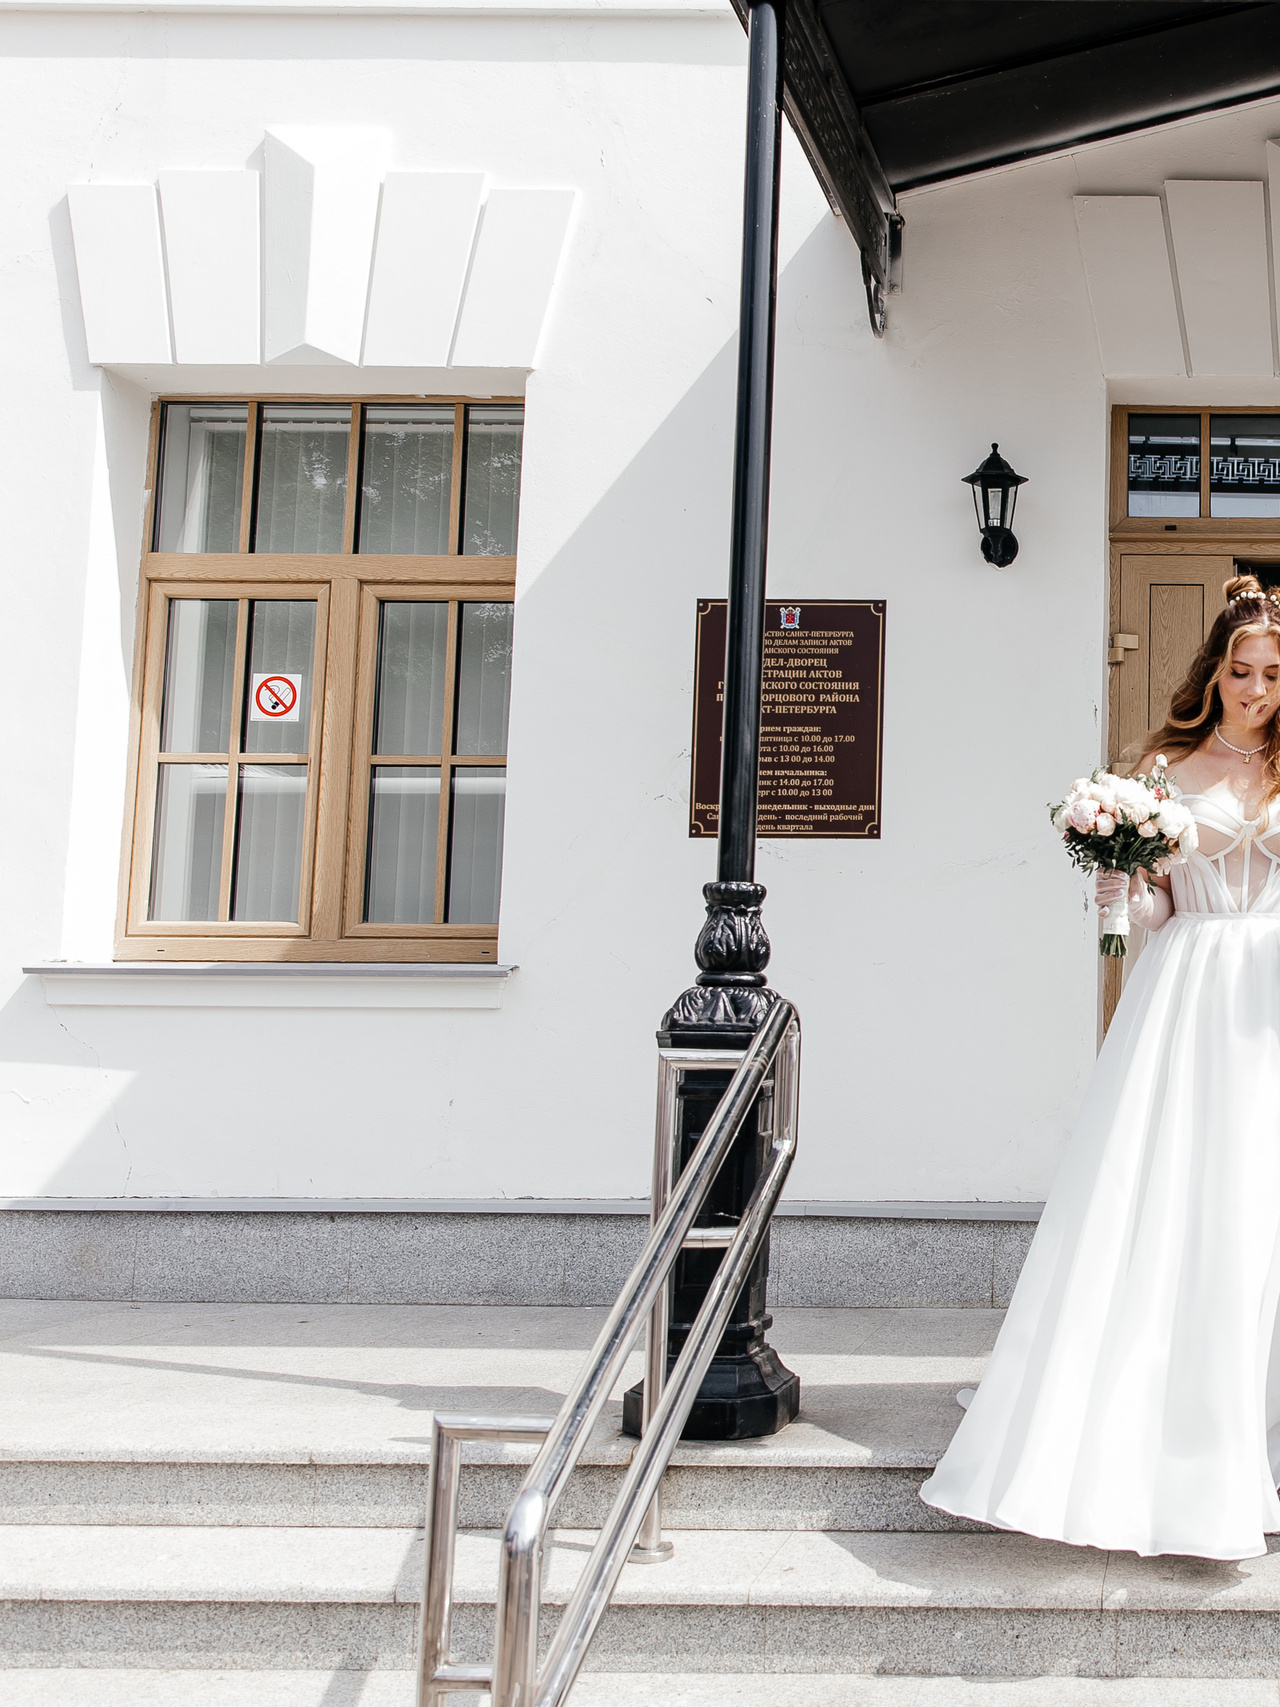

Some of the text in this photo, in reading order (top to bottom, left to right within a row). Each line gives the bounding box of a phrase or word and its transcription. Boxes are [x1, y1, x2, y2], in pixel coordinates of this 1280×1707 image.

[773, 639, 799, 647] ДЕЛАМ
[763, 658, 828, 668] ДЕЛ-ДВОРЕЦ
[809, 670, 843, 678] АКТОВ
[799, 681, 860, 690] СОСТОЯНИЯ
[820, 692, 860, 702] РАЙОНА
[802, 756, 812, 764] до
[859, 804, 875, 812] дни
[785, 813, 828, 821] последний
[829, 813, 863, 821] рабочий
[777, 824, 813, 832] квартала
